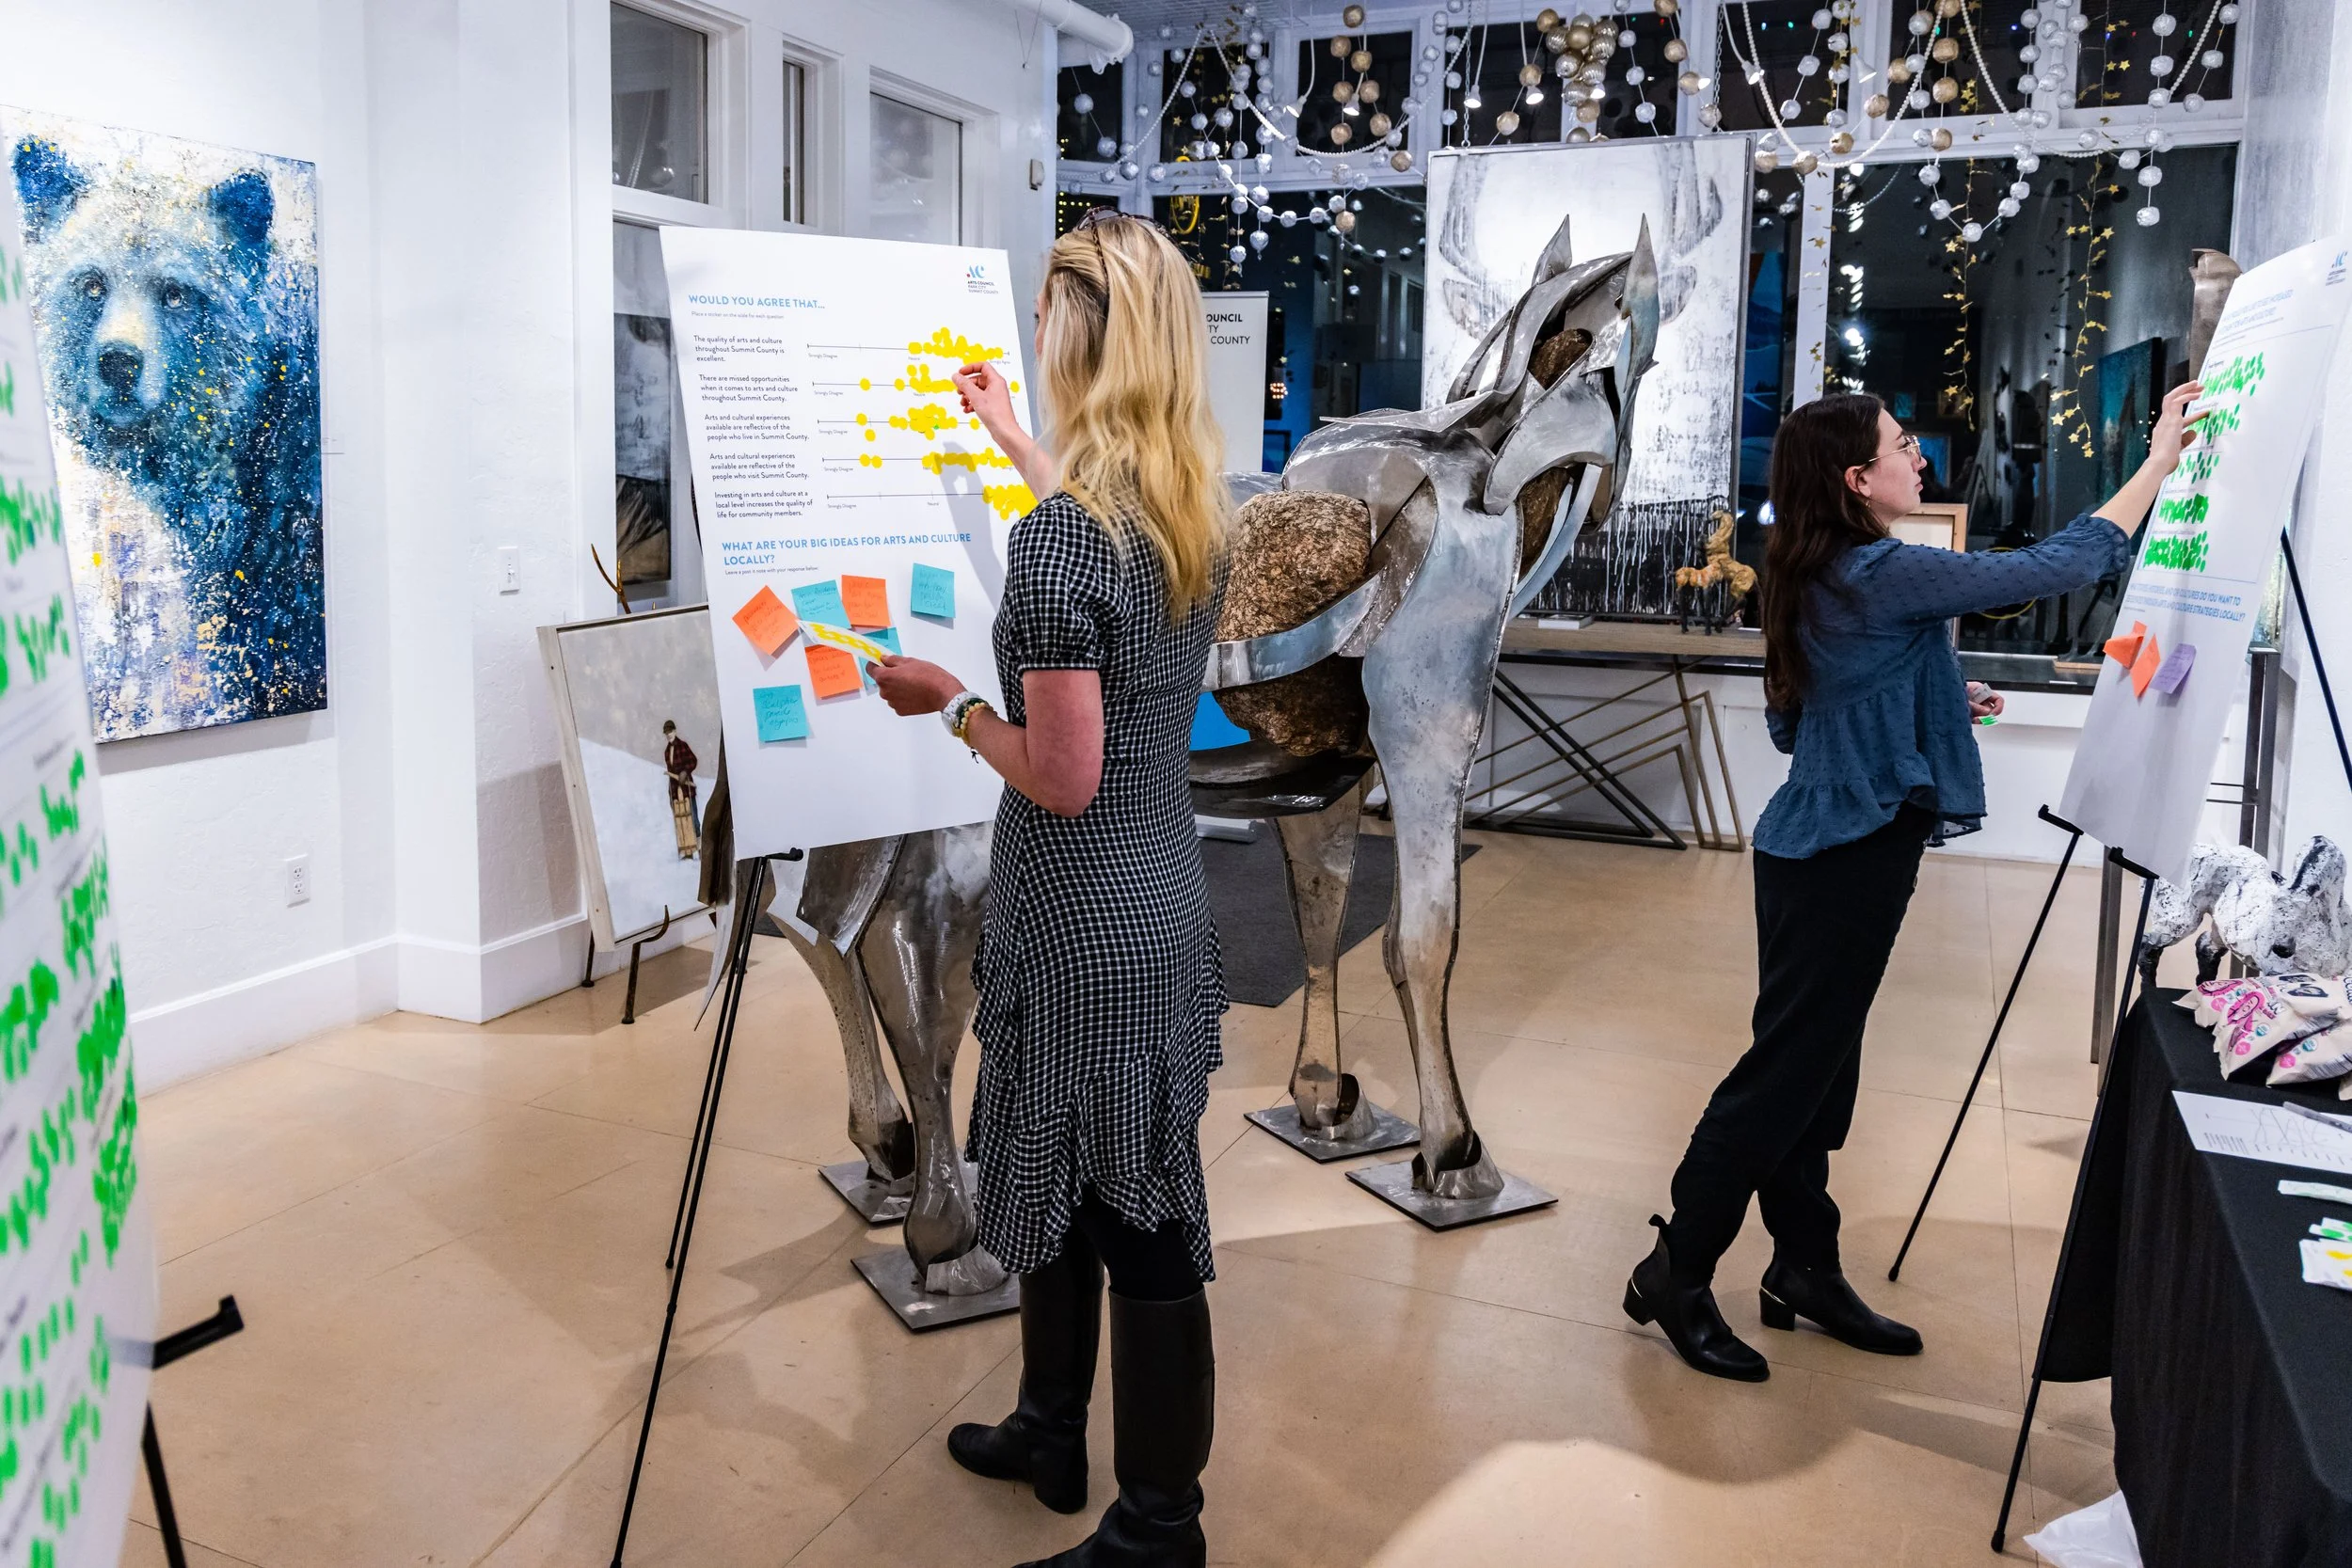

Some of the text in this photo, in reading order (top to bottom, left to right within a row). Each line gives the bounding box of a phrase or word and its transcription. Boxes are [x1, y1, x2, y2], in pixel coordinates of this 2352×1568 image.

[689, 294, 825, 309] WOULD YOU AGREE THAT...
[1206, 313, 1243, 323] OUNCIL
[707, 336, 727, 344] quality
[1210, 336, 1250, 344] COUNTY
[695, 345, 730, 355] throughout
[756, 346, 778, 356] County
[702, 394, 737, 404] throughout
[762, 394, 787, 404] County.
[755, 414, 790, 423] experiences
[743, 422, 771, 431] reflective
[707, 433, 727, 442] people
[786, 433, 809, 442] County.
[761, 452, 795, 461] experiences
[712, 473, 733, 482] people
[786, 471, 809, 481] County.
[715, 492, 742, 500] Investing
[786, 499, 805, 508] quality
[722, 533, 971, 551] WHAT ARE YOUR BIG IDEAS FOR ARTS AND CULTURE
[724, 554, 774, 565] LOCALLY?
[2219, 609, 2246, 622] LOCALLY?
